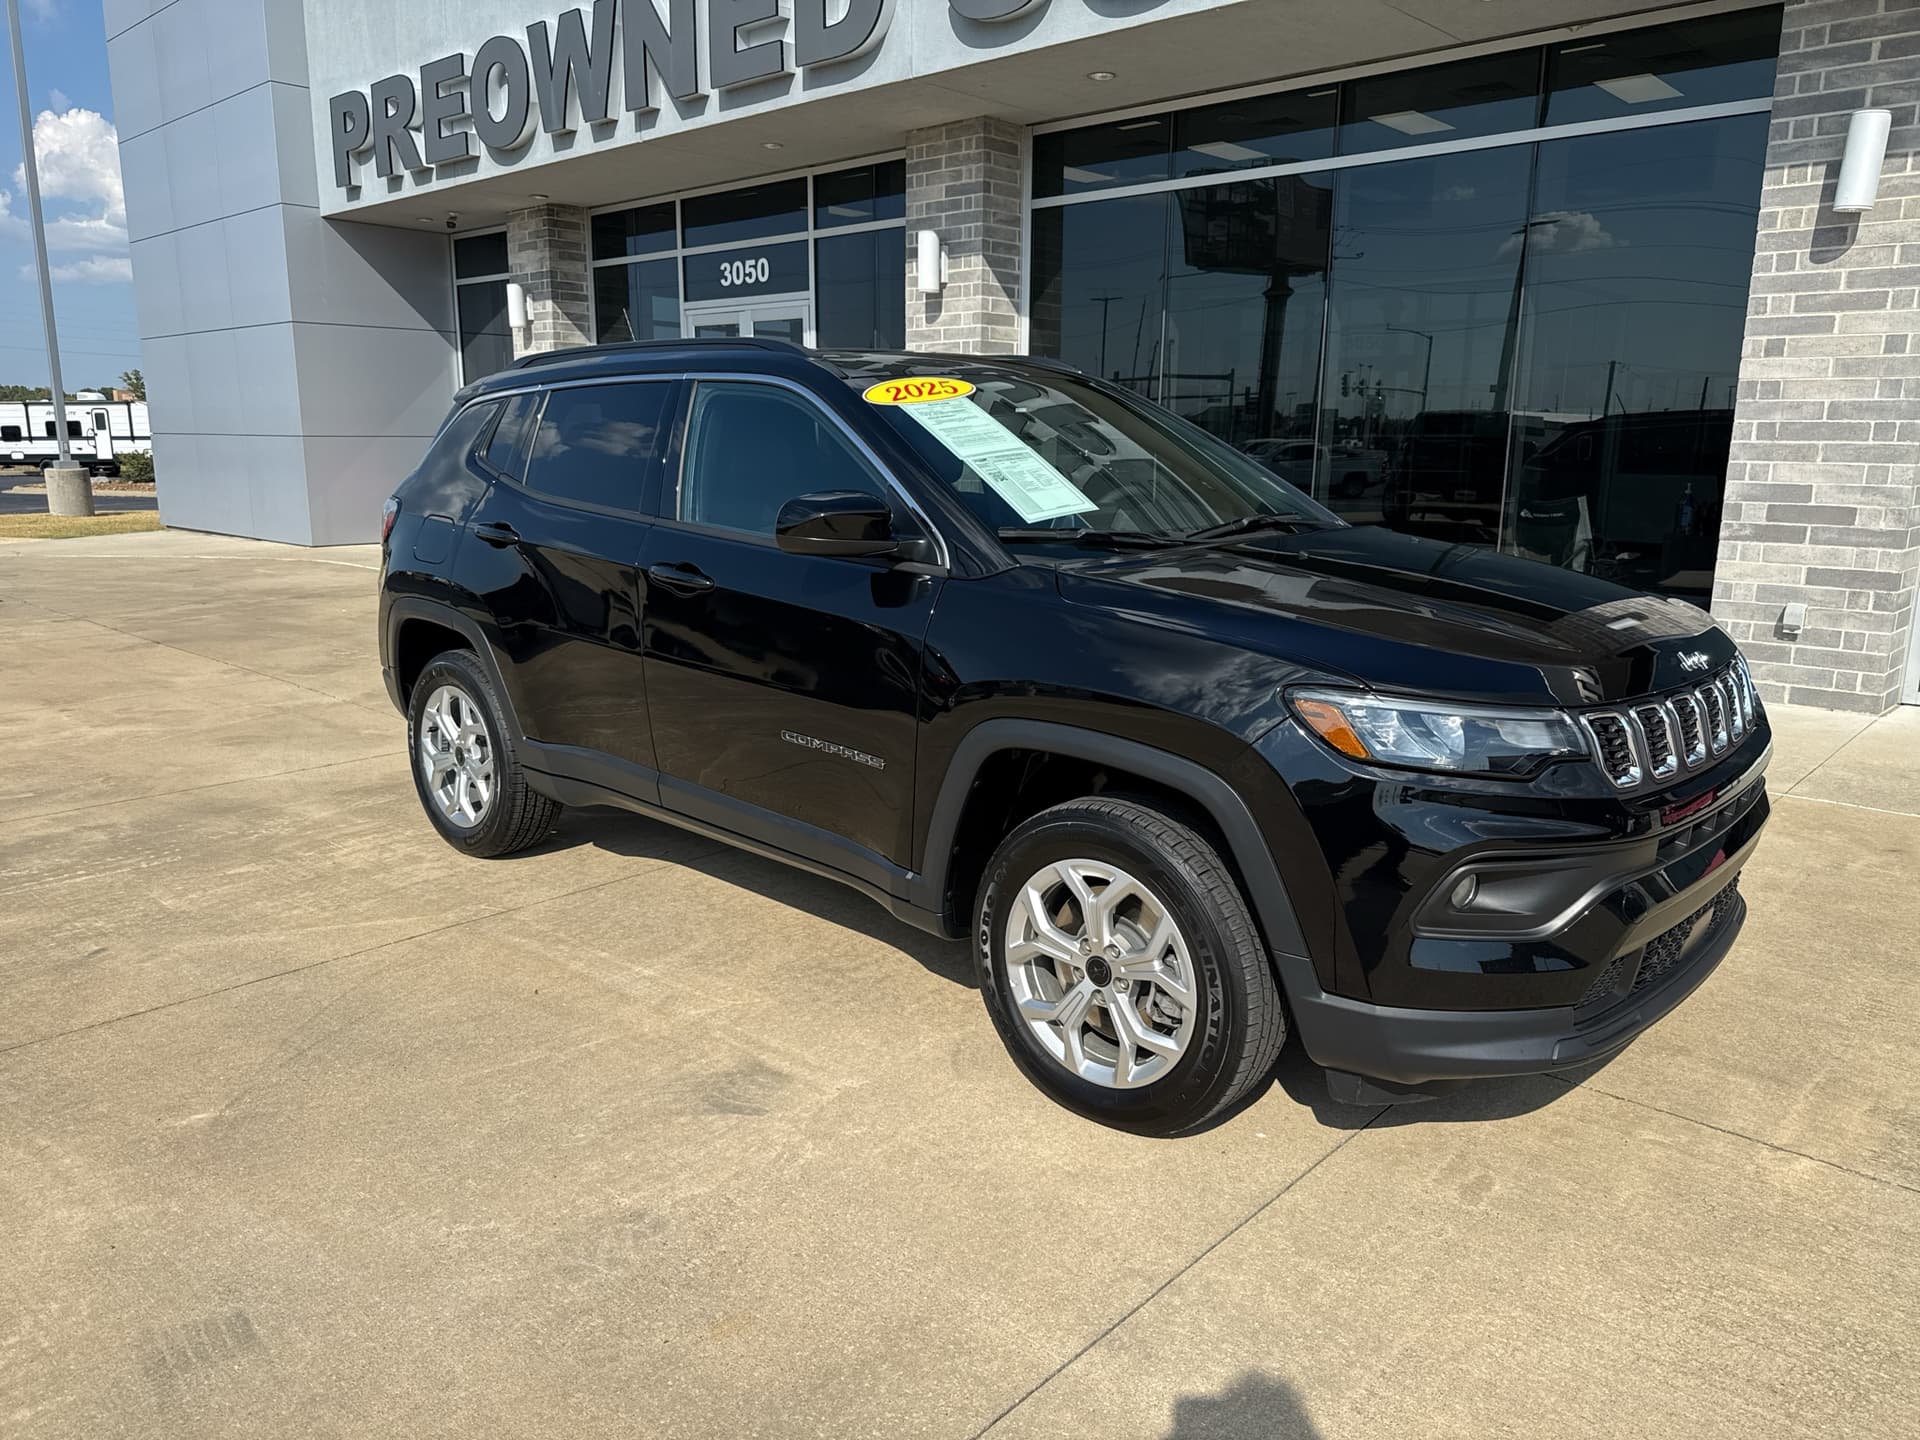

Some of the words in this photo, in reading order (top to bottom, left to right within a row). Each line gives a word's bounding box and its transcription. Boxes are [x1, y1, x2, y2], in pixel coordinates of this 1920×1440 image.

[720, 257, 769, 287] 3050
[885, 381, 960, 402] 2025
[781, 730, 886, 770] COMPASS
